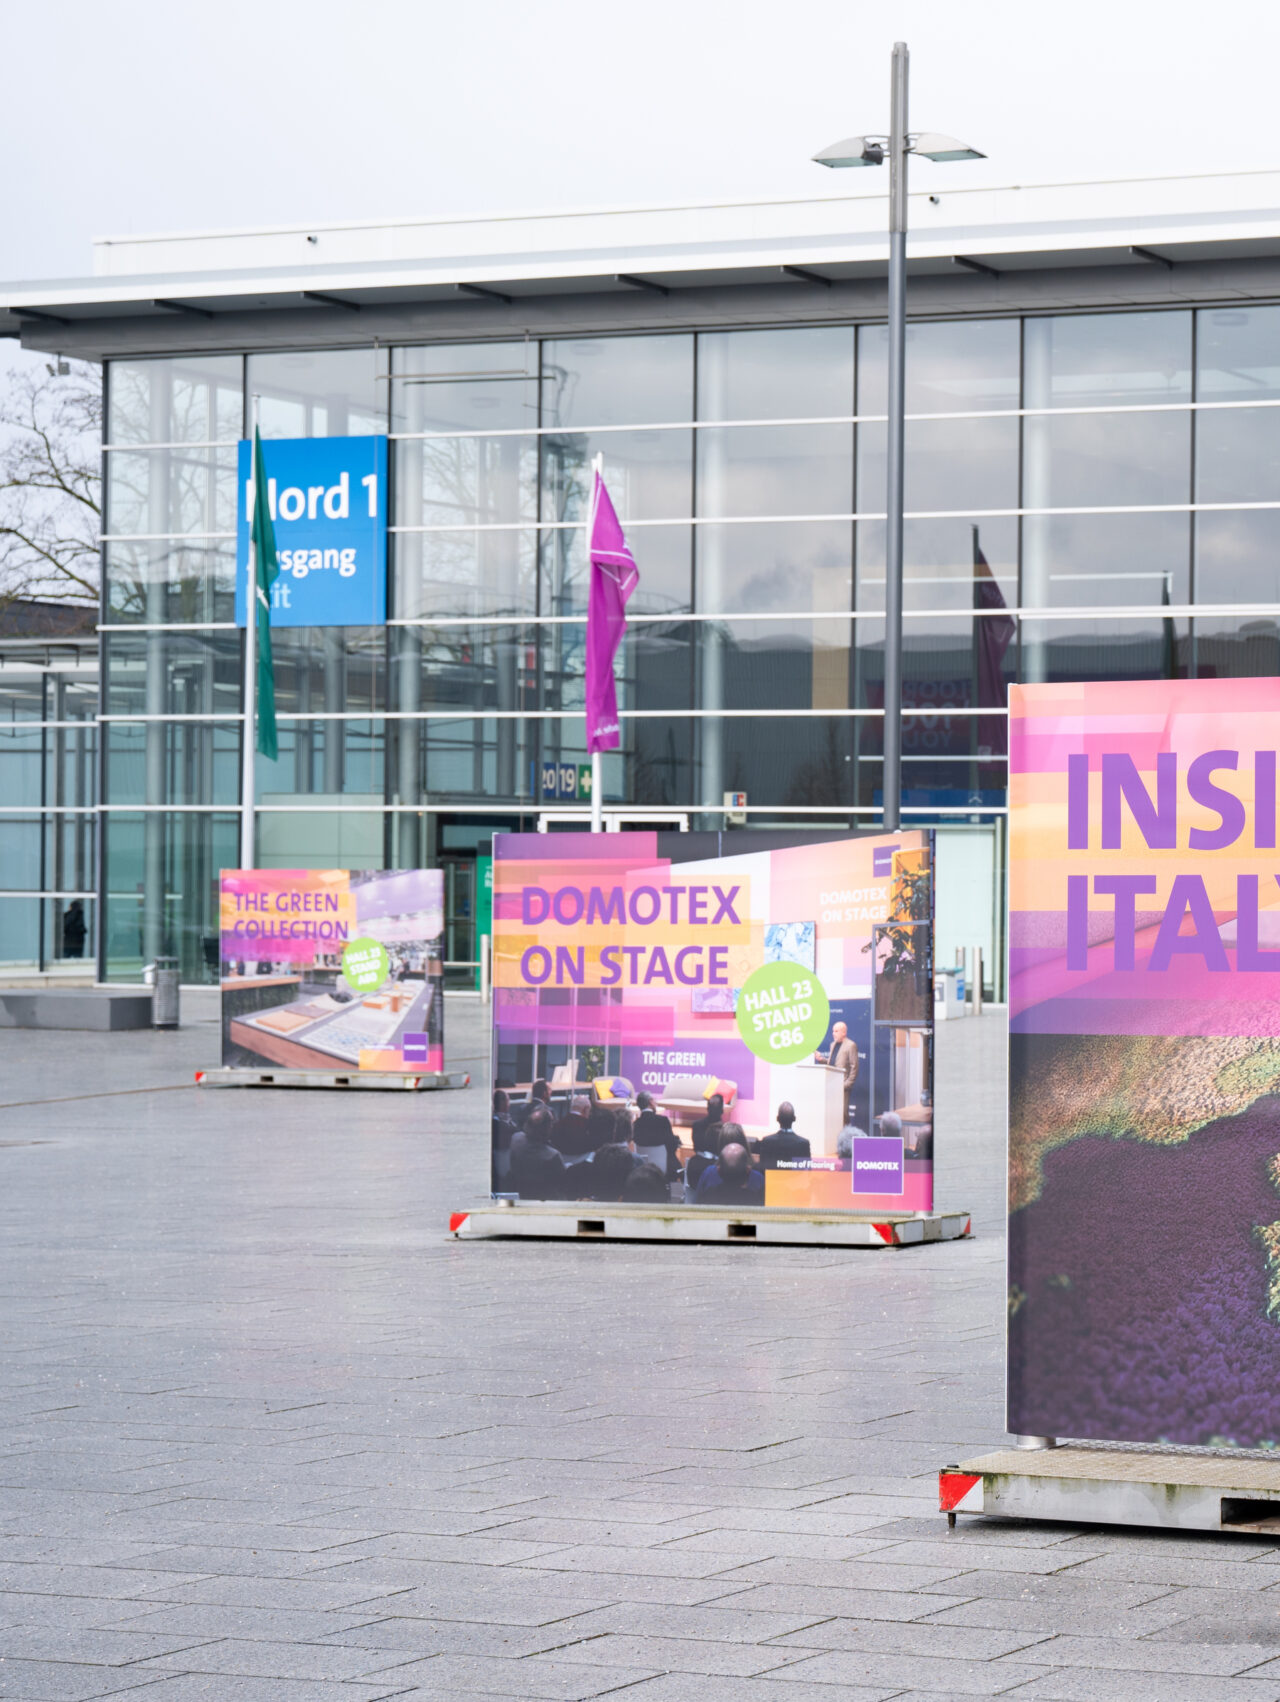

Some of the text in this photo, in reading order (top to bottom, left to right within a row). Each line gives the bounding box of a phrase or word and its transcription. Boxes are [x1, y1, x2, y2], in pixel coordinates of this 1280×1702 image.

[361, 474, 377, 517] 1
[246, 548, 356, 578] sgang
[560, 768, 575, 793] 19
[234, 893, 339, 912] THE GREEN
[522, 885, 741, 925] DOMOTEX
[820, 887, 887, 905] DOMOTEX
[822, 905, 887, 923] ON STAGE
[234, 920, 348, 939] COLLECTION
[520, 945, 729, 985] ON STAGE
[744, 980, 813, 1012] HALL 23
[752, 1002, 812, 1032] STAND
[769, 1026, 804, 1050] C86
[642, 1051, 706, 1067] THE GREEN
[777, 1160, 835, 1171] Home of Flooring
[856, 1161, 899, 1170] DOMOTEX
